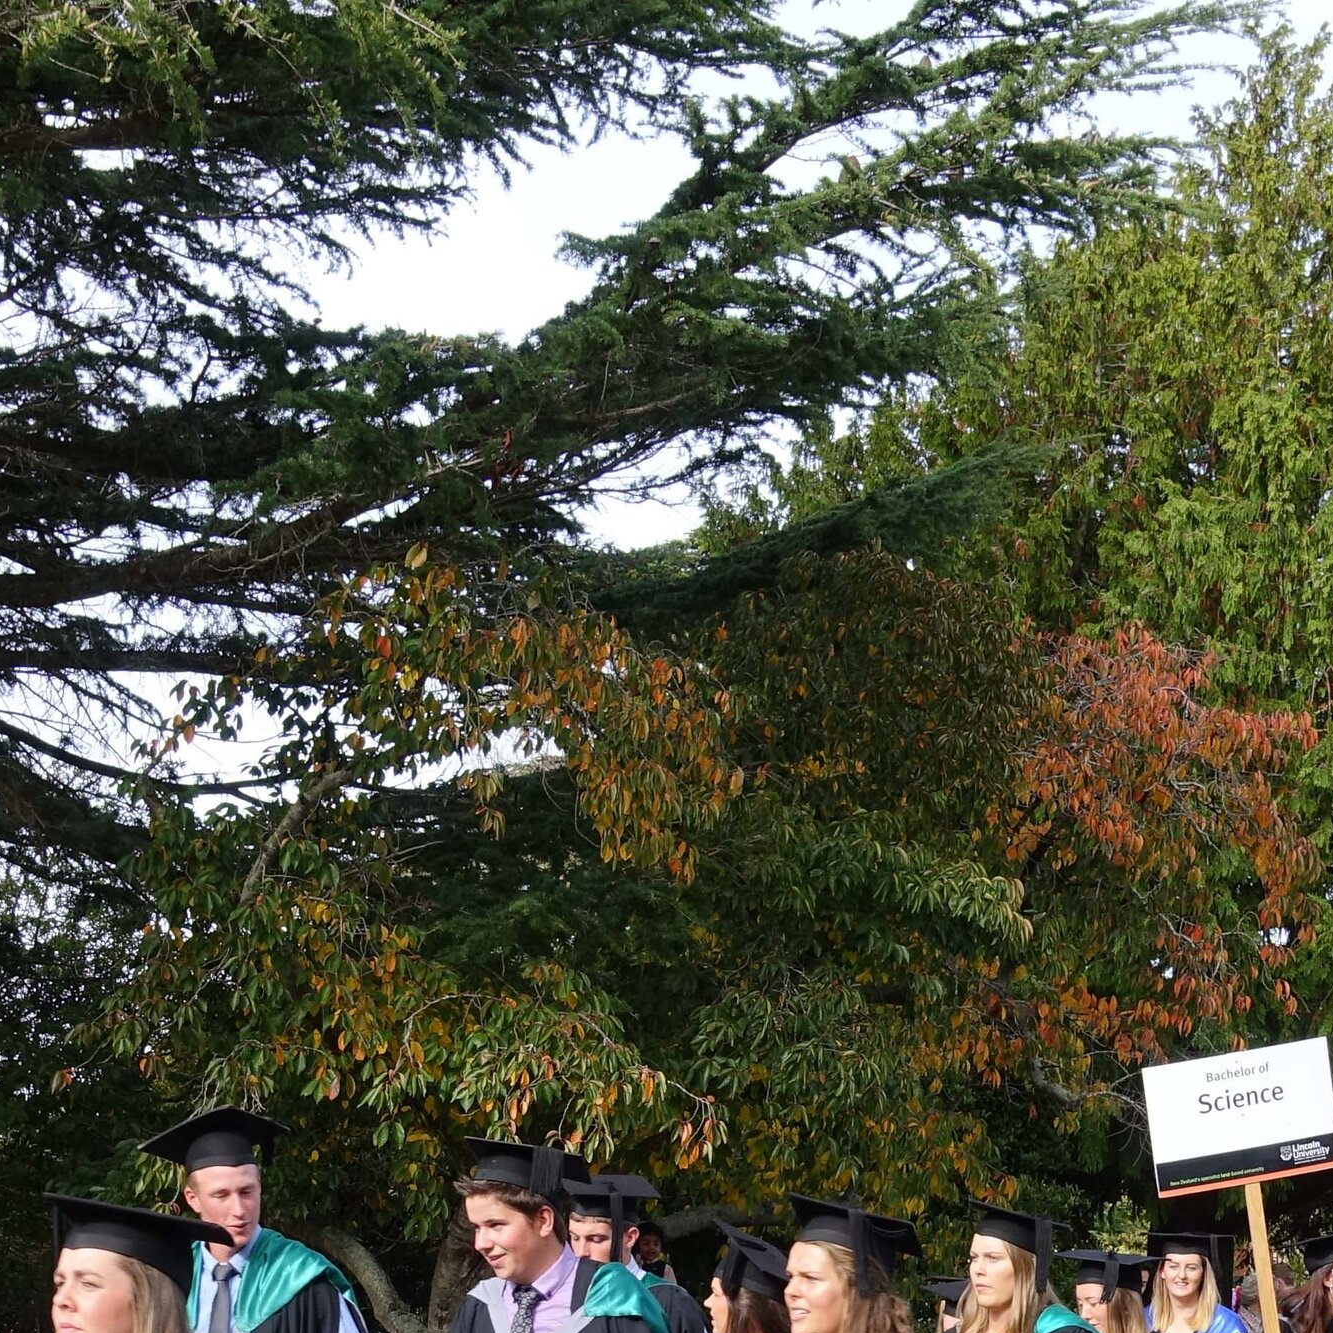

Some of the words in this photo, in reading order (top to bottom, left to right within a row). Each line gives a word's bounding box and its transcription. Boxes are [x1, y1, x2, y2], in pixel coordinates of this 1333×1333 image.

[1206, 1066, 1256, 1083] Bachelor
[1258, 1060, 1269, 1073] of
[1198, 1086, 1284, 1114] Science
[1292, 1141, 1321, 1153] Lincoln
[1293, 1146, 1330, 1159] University
